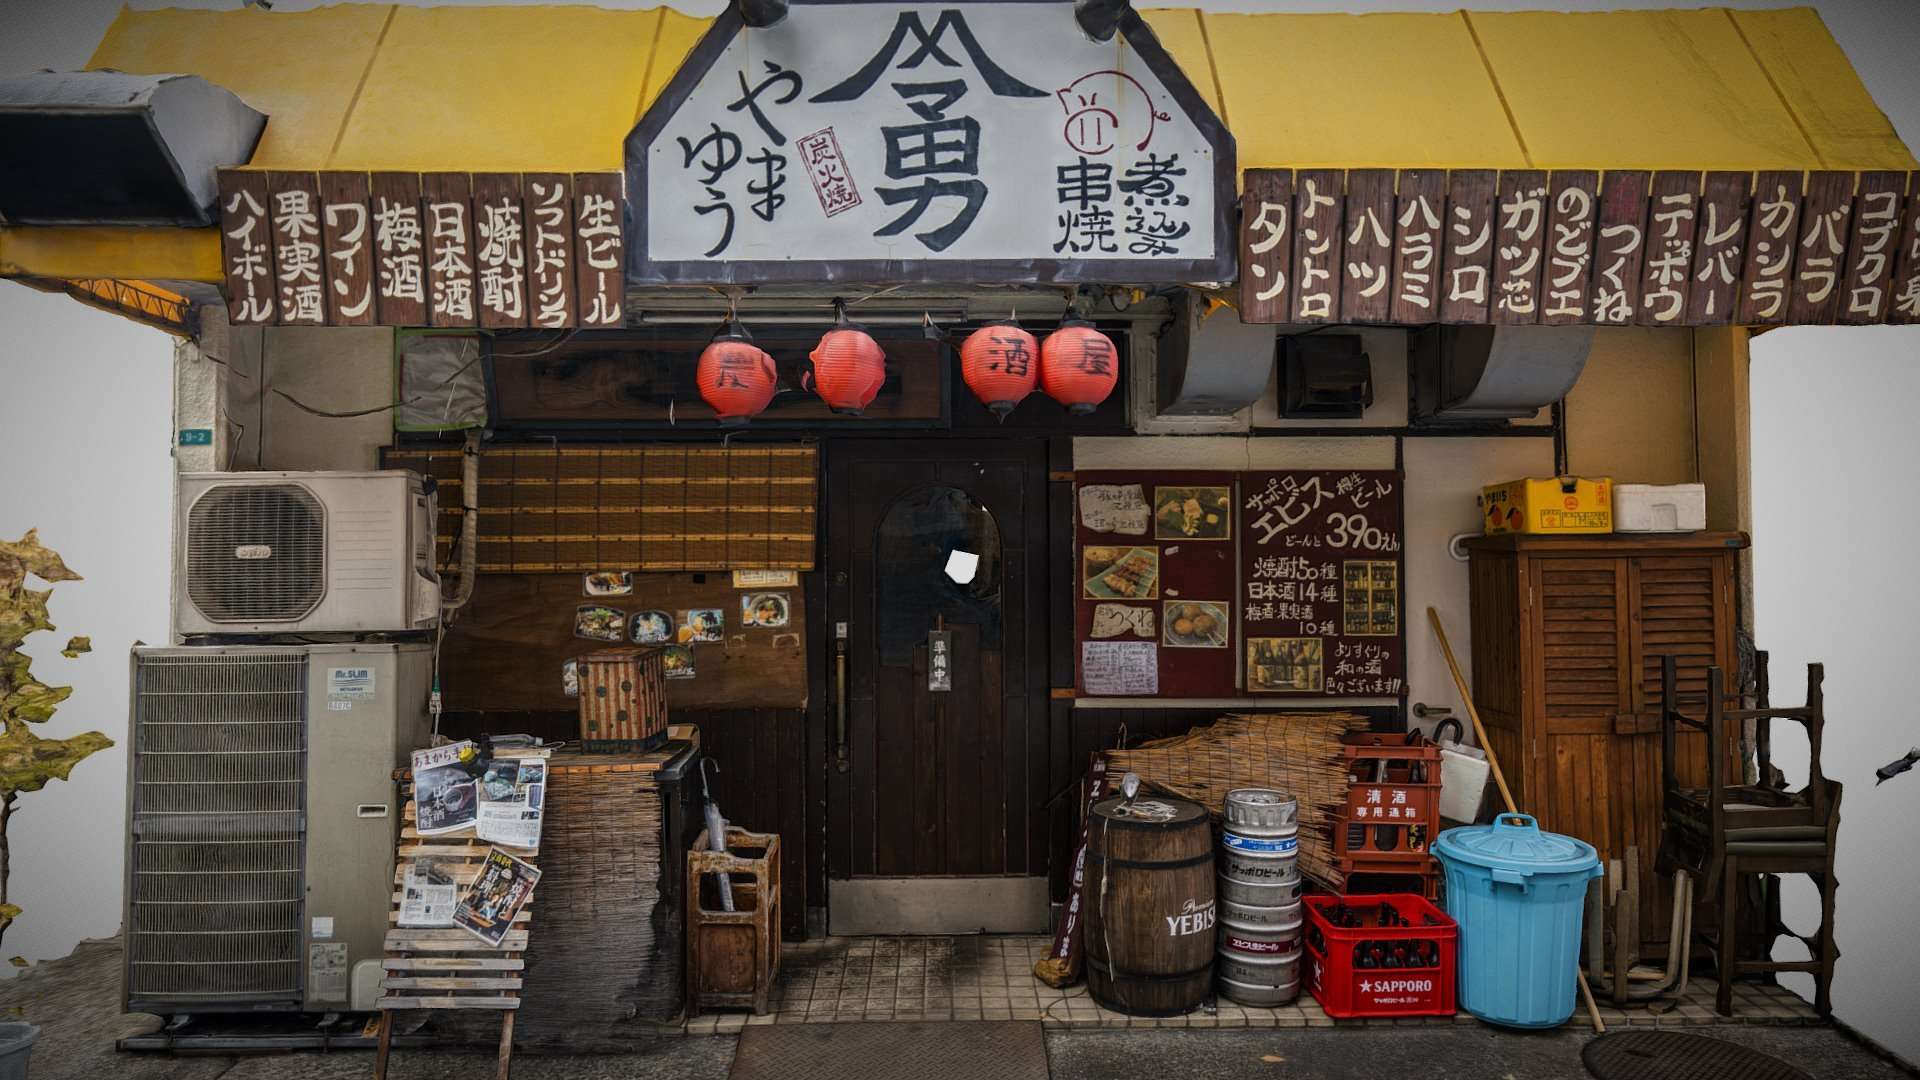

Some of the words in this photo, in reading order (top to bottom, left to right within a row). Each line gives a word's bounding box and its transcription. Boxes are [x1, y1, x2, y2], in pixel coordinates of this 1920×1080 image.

[677, 123, 742, 257] ゆう
[727, 60, 803, 222] やま
[809, 137, 853, 208] 炭火焼
[227, 189, 273, 322] ハイボール
[275, 190, 324, 322] 果実酒
[373, 197, 424, 302] 梅酒
[479, 197, 523, 319] 焼酎
[533, 182, 567, 328] ソフトドリンク
[1053, 156, 1117, 253] 串焼
[1117, 152, 1190, 256] 煮込み
[1250, 201, 1286, 301] タン
[1300, 179, 1335, 317] トントロ
[1348, 207, 1390, 298] ハツ
[1398, 195, 1441, 308] ハラミ
[1449, 206, 1490, 304] シロ
[1545, 187, 1592, 317] のどブエ
[1644, 193, 1694, 321] テッポウ
[1750, 185, 1796, 317] カシラ
[1801, 205, 1850, 303] バラ
[1849, 192, 1898, 317] コブクロ
[326, 203, 371, 317] ワイン
[431, 202, 472, 320] 日本酒
[579, 194, 621, 324] 生ビール
[1593, 224, 1641, 322] つくね
[1698, 203, 1742, 315] レバー
[988, 336, 1029, 376] 酒
[1245, 475, 1298, 511] サッポロ
[1251, 476, 1335, 544] エビス
[1351, 479, 1392, 509] ビール
[933, 640, 947, 682] 準備中
[1166, 904, 1216, 936] YEBIS
[1374, 980, 1432, 993] SAPPORO
